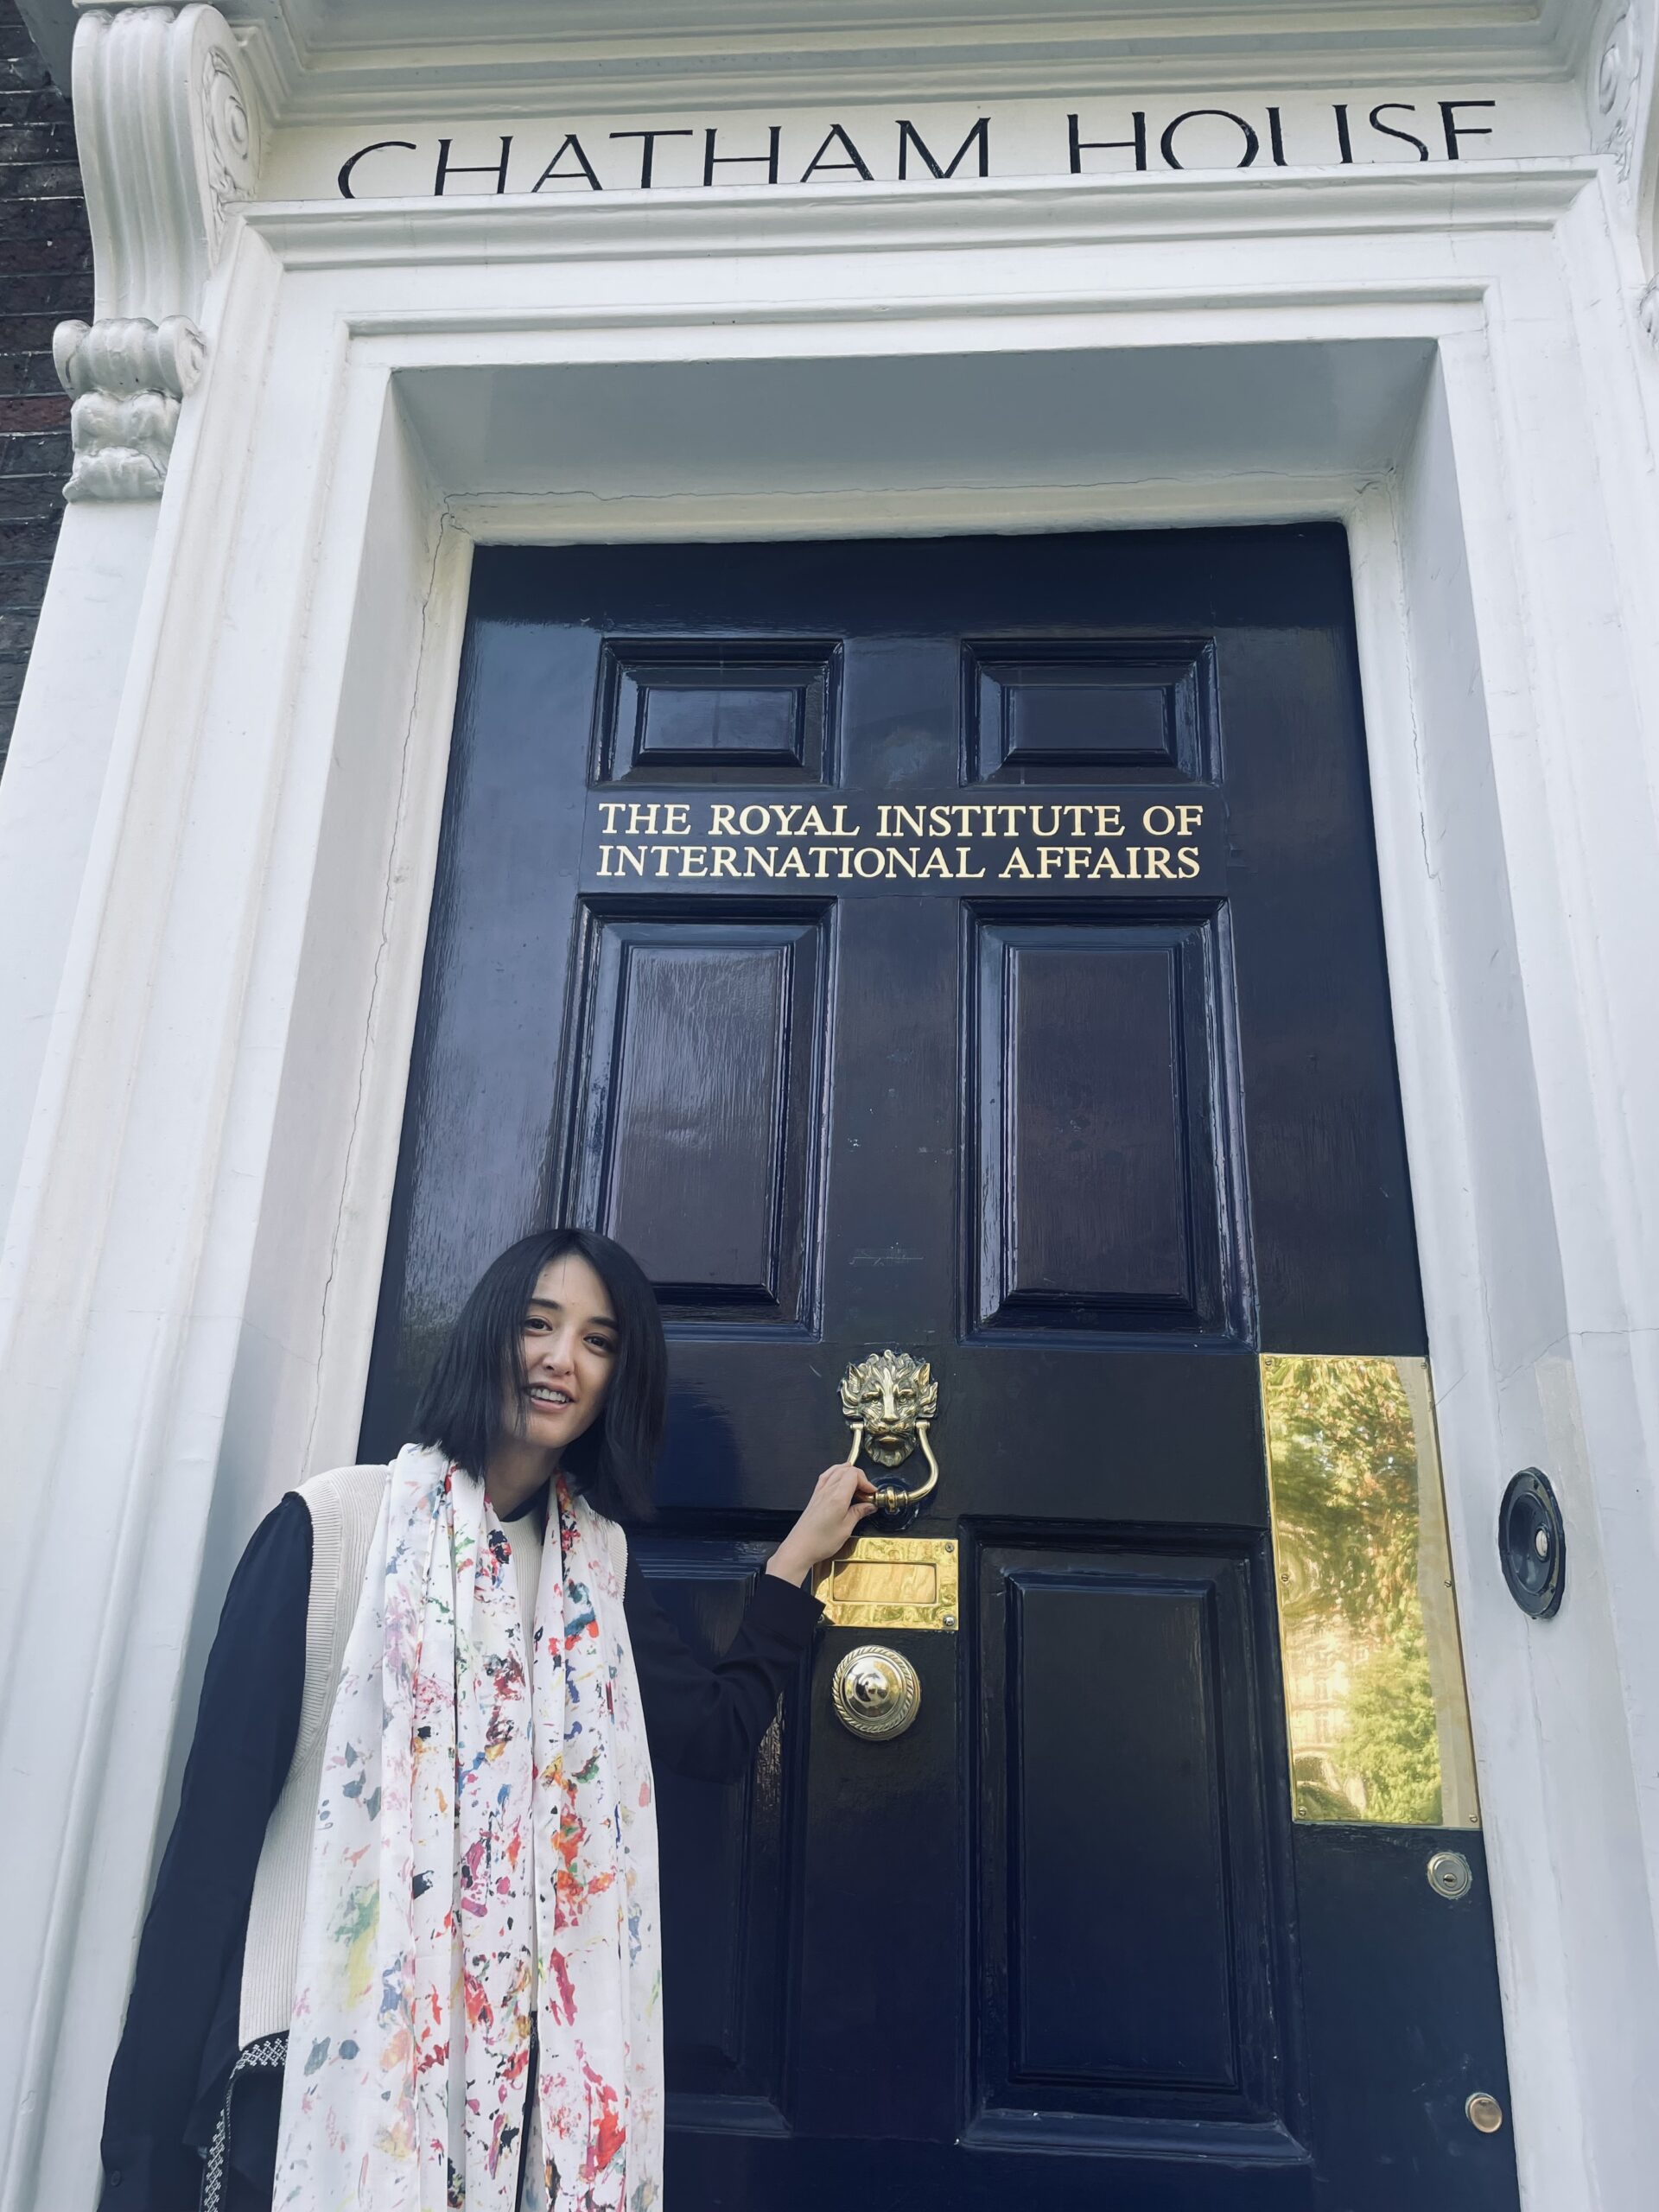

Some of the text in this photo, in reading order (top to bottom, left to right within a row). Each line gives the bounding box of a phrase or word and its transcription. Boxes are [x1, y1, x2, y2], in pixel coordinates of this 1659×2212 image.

[338, 99, 1496, 200] CHATHAM HOUSE
[598, 802, 1204, 837] THE ROYAL INSTITUTE OF
[595, 844, 1201, 880] INTERNATIONAL AFFAIRS
